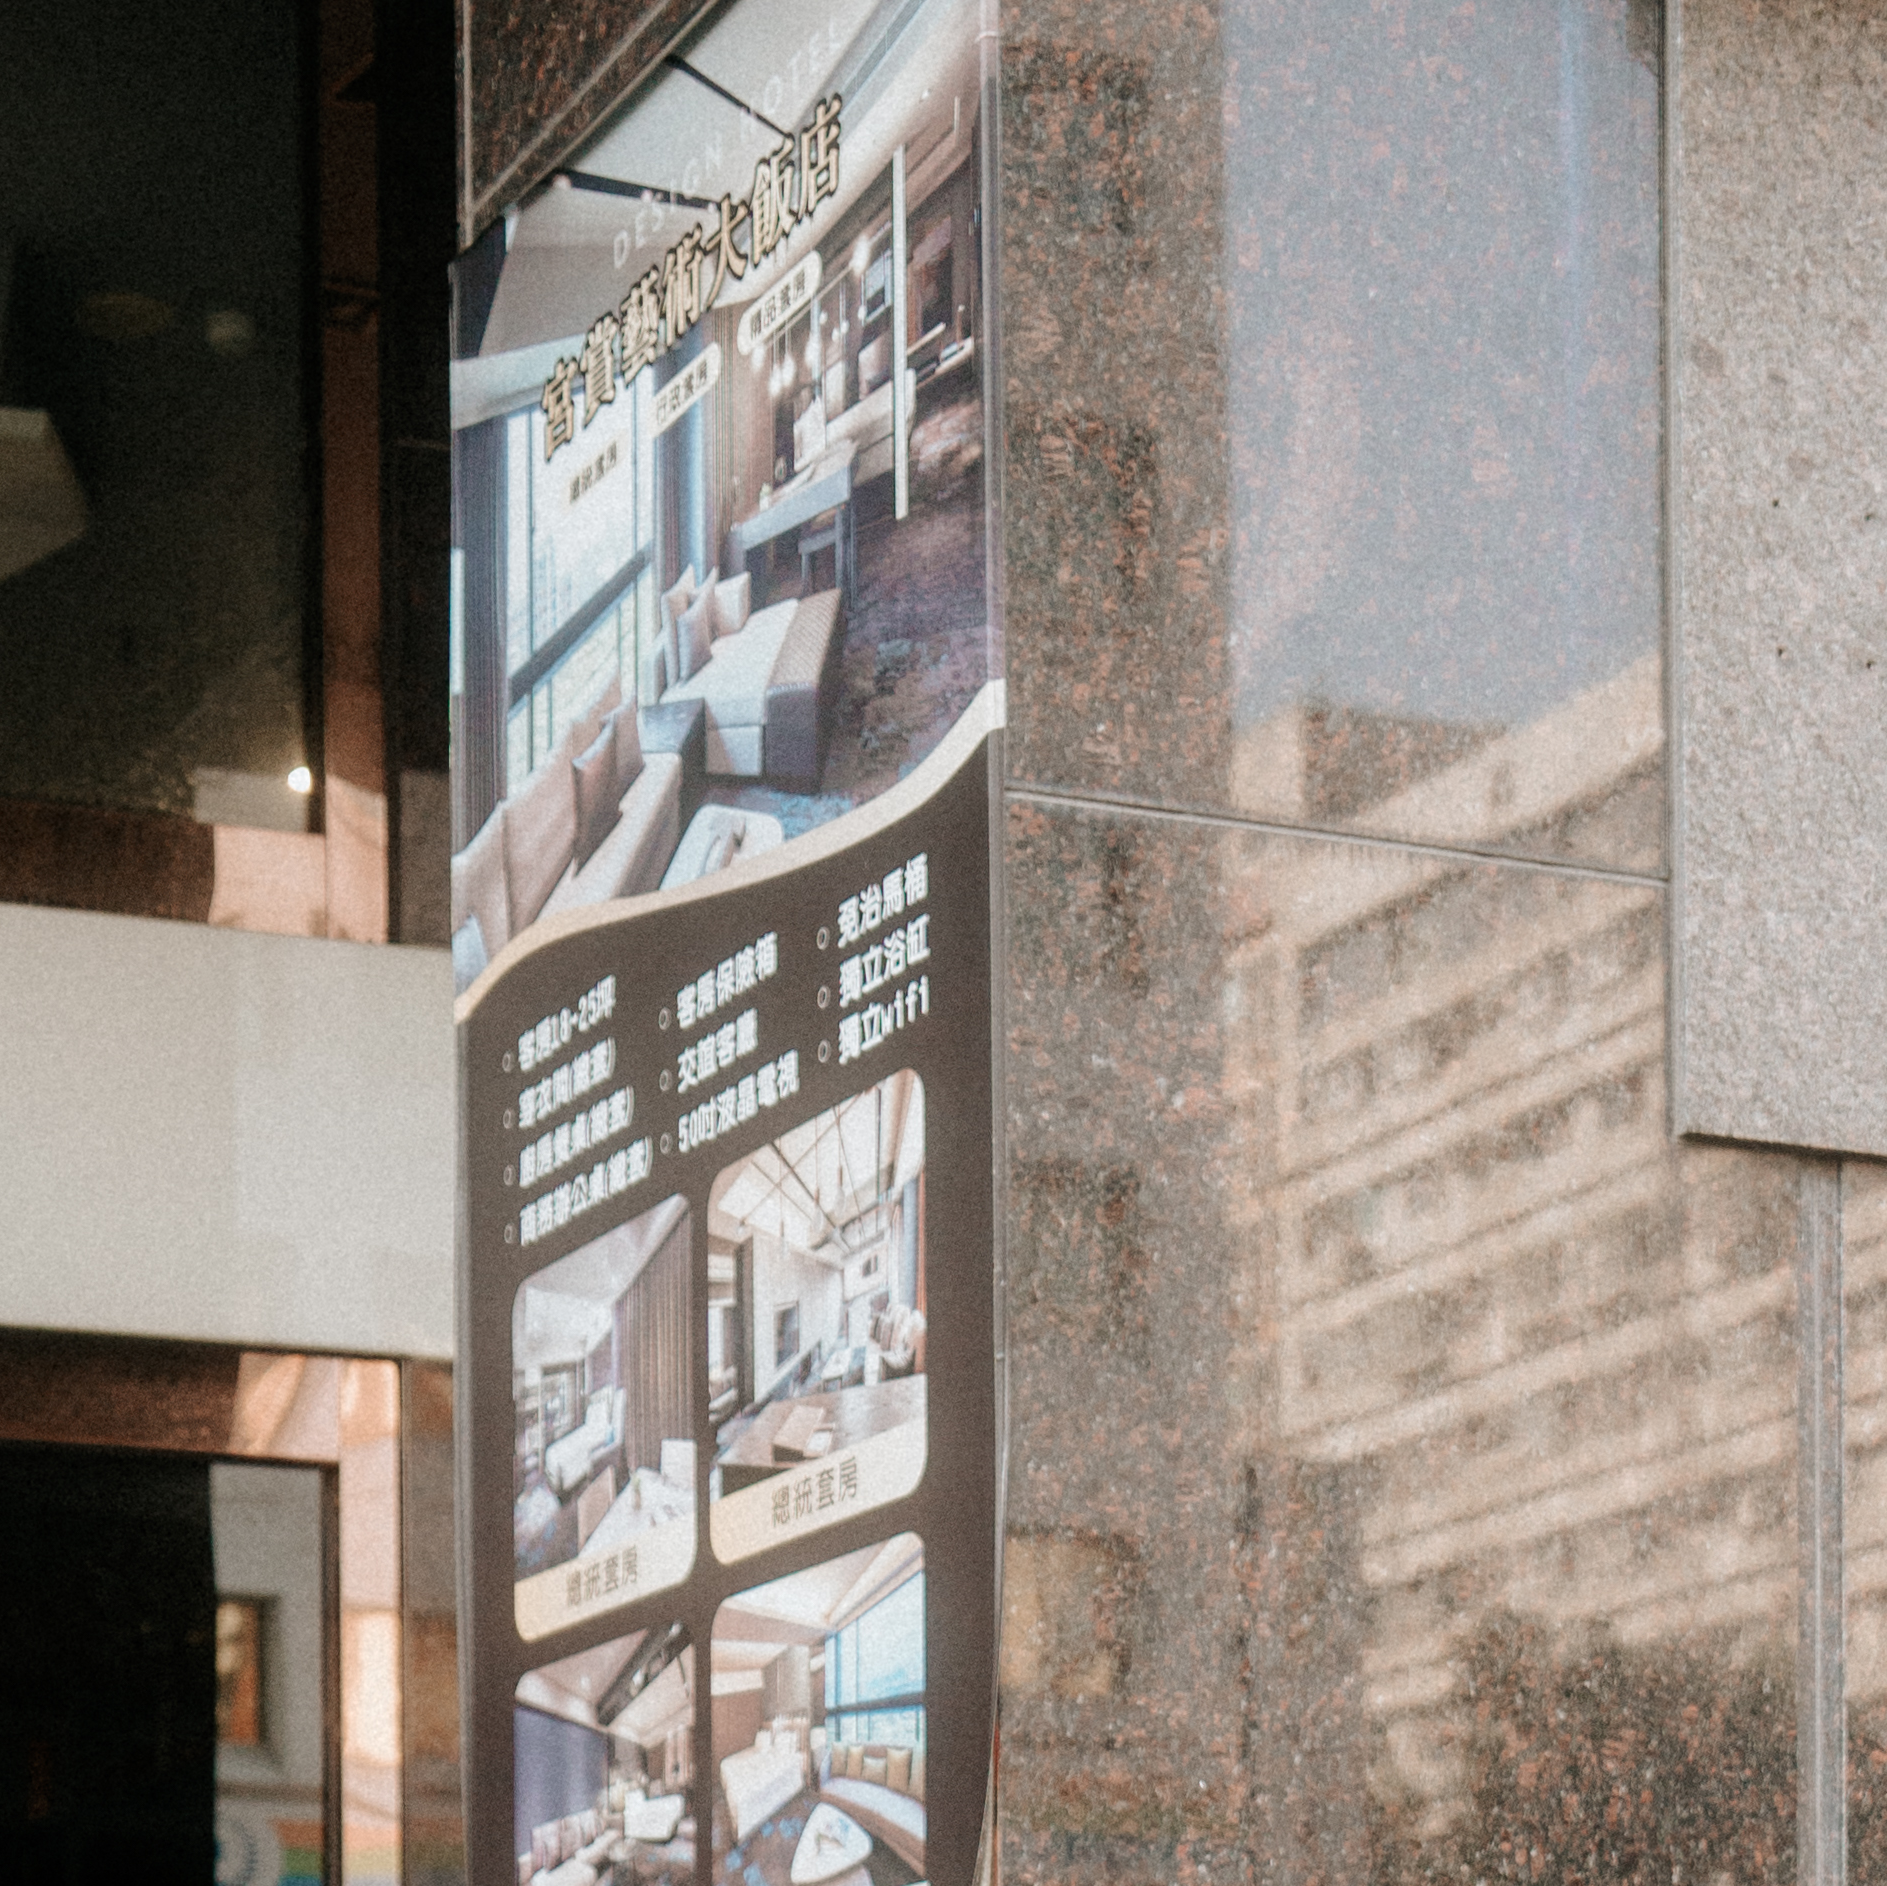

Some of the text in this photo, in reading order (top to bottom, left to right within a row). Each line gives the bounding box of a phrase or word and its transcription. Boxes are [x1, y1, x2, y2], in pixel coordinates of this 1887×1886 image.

[541, 93, 842, 463] 宮賞藝術大飯店
[838, 852, 929, 949] 免治馬桶
[677, 931, 778, 1030] 客房保險箱
[839, 913, 931, 1008] 獨立浴缸
[771, 1456, 858, 1529] 總統套房
[566, 1545, 639, 1606] 總統套房
